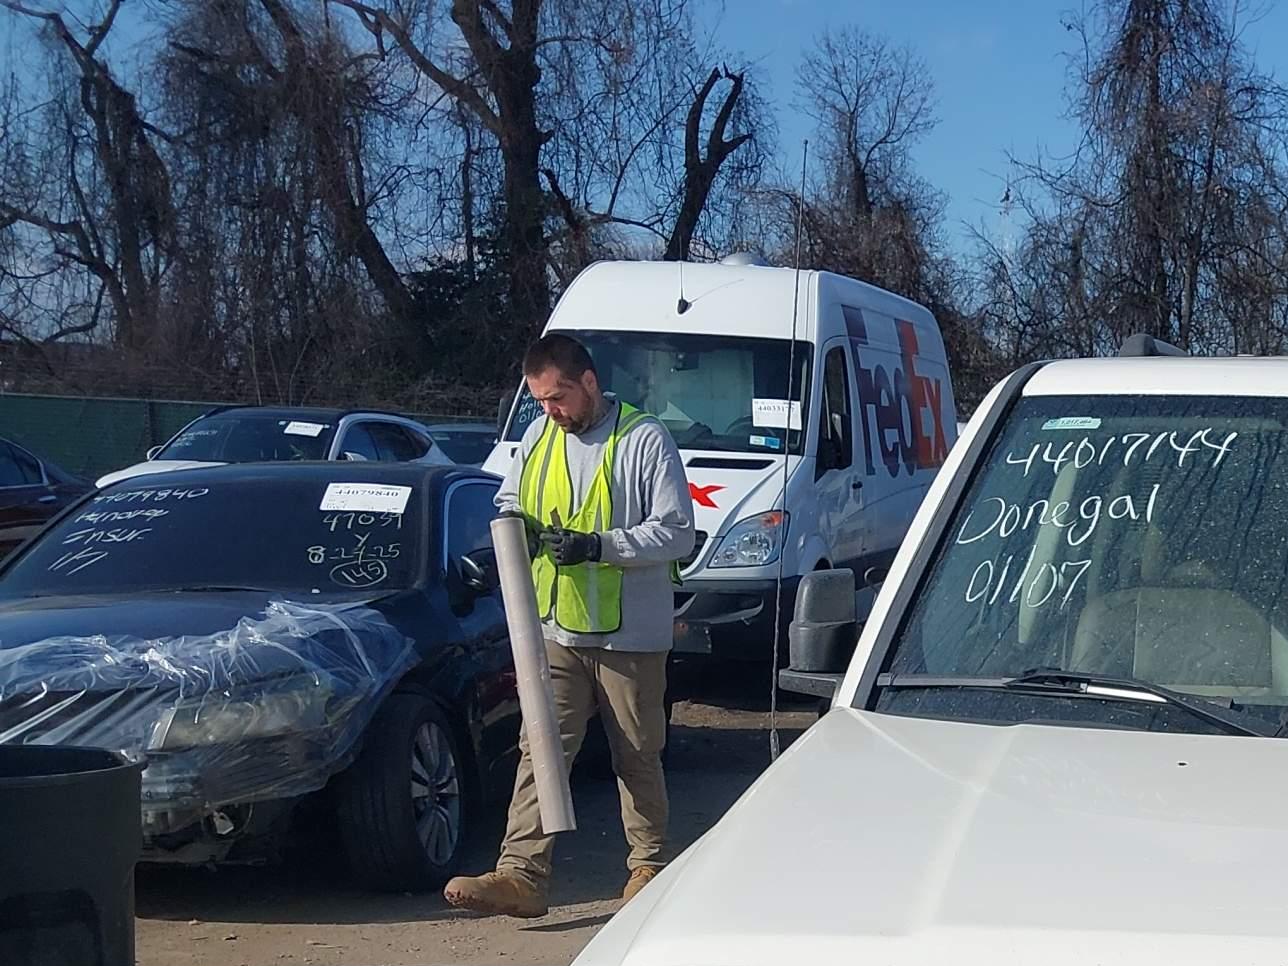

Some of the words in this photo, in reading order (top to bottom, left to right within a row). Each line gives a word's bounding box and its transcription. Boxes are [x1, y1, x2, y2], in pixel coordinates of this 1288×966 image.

[841, 304, 950, 478] FedEx
[1006, 428, 1238, 477] 44017144
[956, 484, 1160, 545] Donegal
[966, 544, 1092, 610] 01/07
